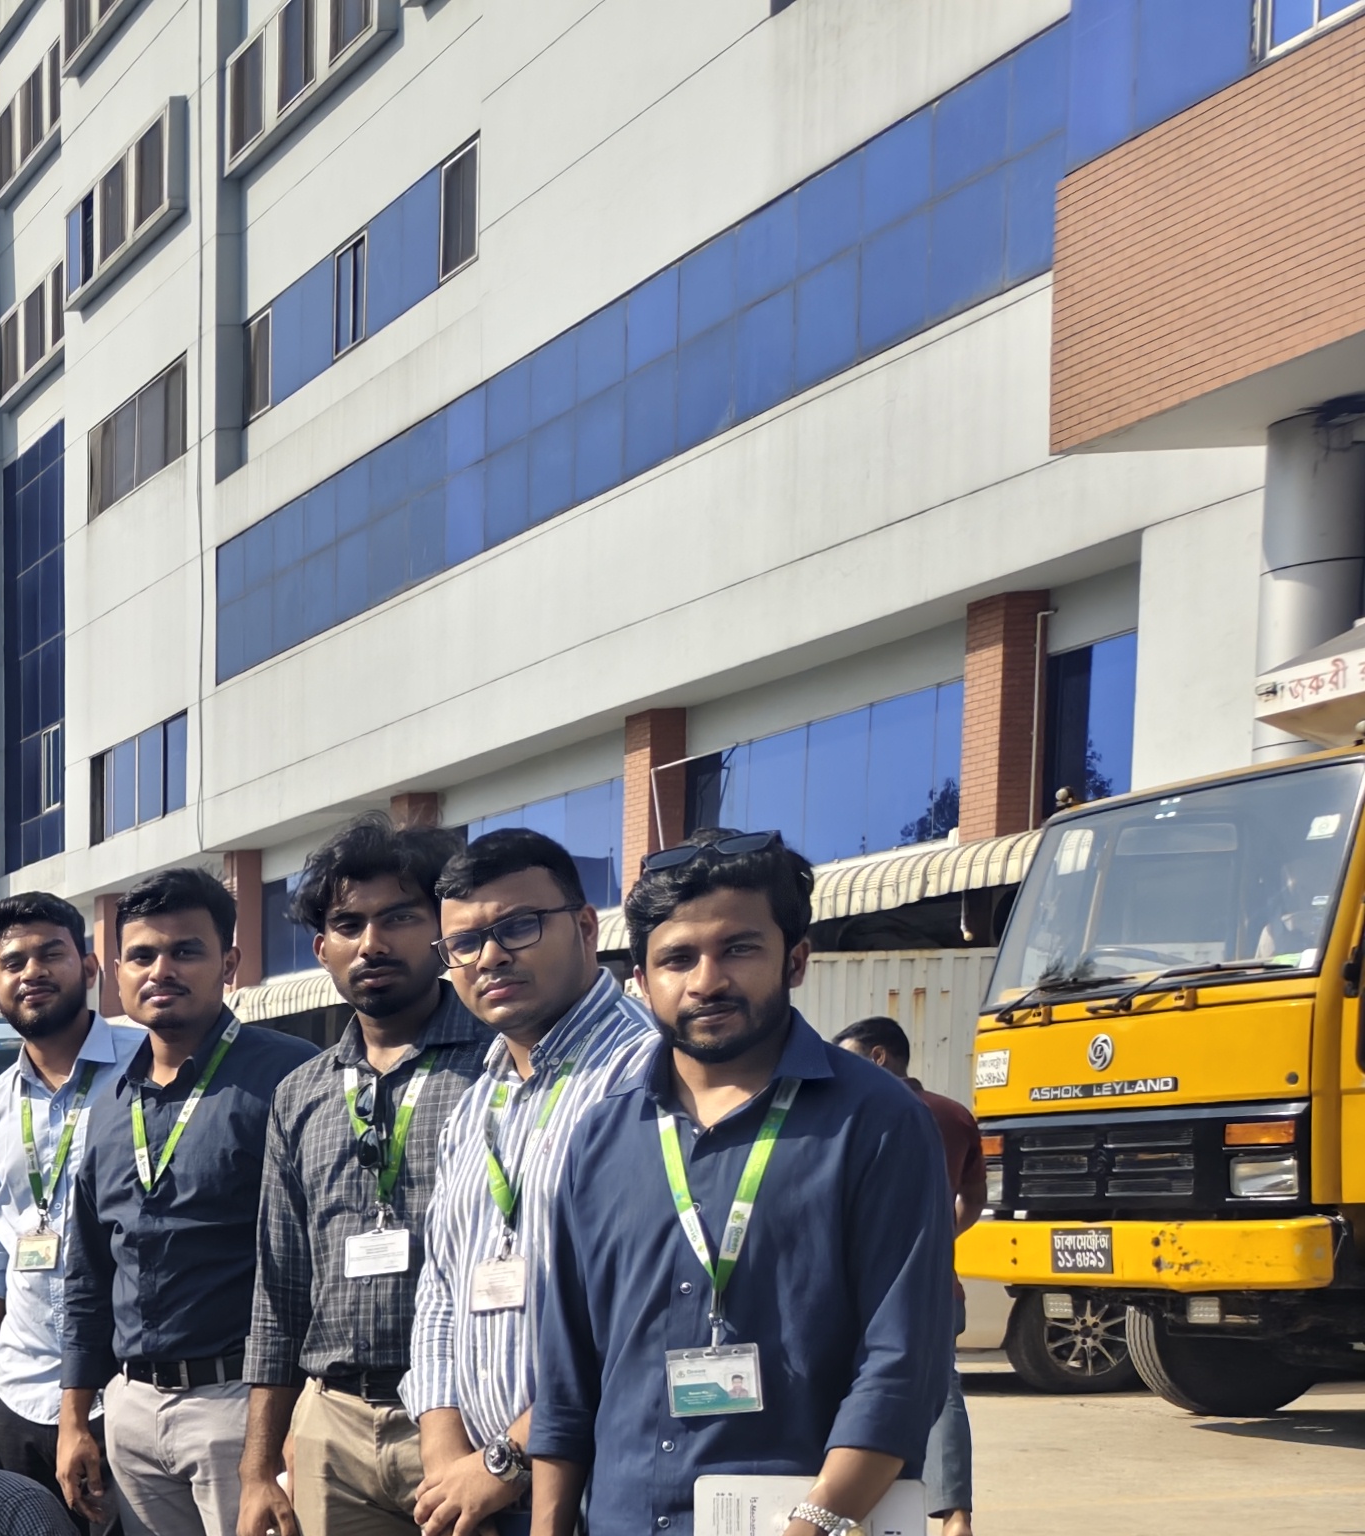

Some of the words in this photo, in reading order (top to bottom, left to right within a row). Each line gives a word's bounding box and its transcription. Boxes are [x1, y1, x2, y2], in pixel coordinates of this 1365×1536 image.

[1031, 1085, 1083, 1100] ASHOK
[1092, 1077, 1173, 1096] LEYLAND
[730, 1226, 744, 1254] Green
